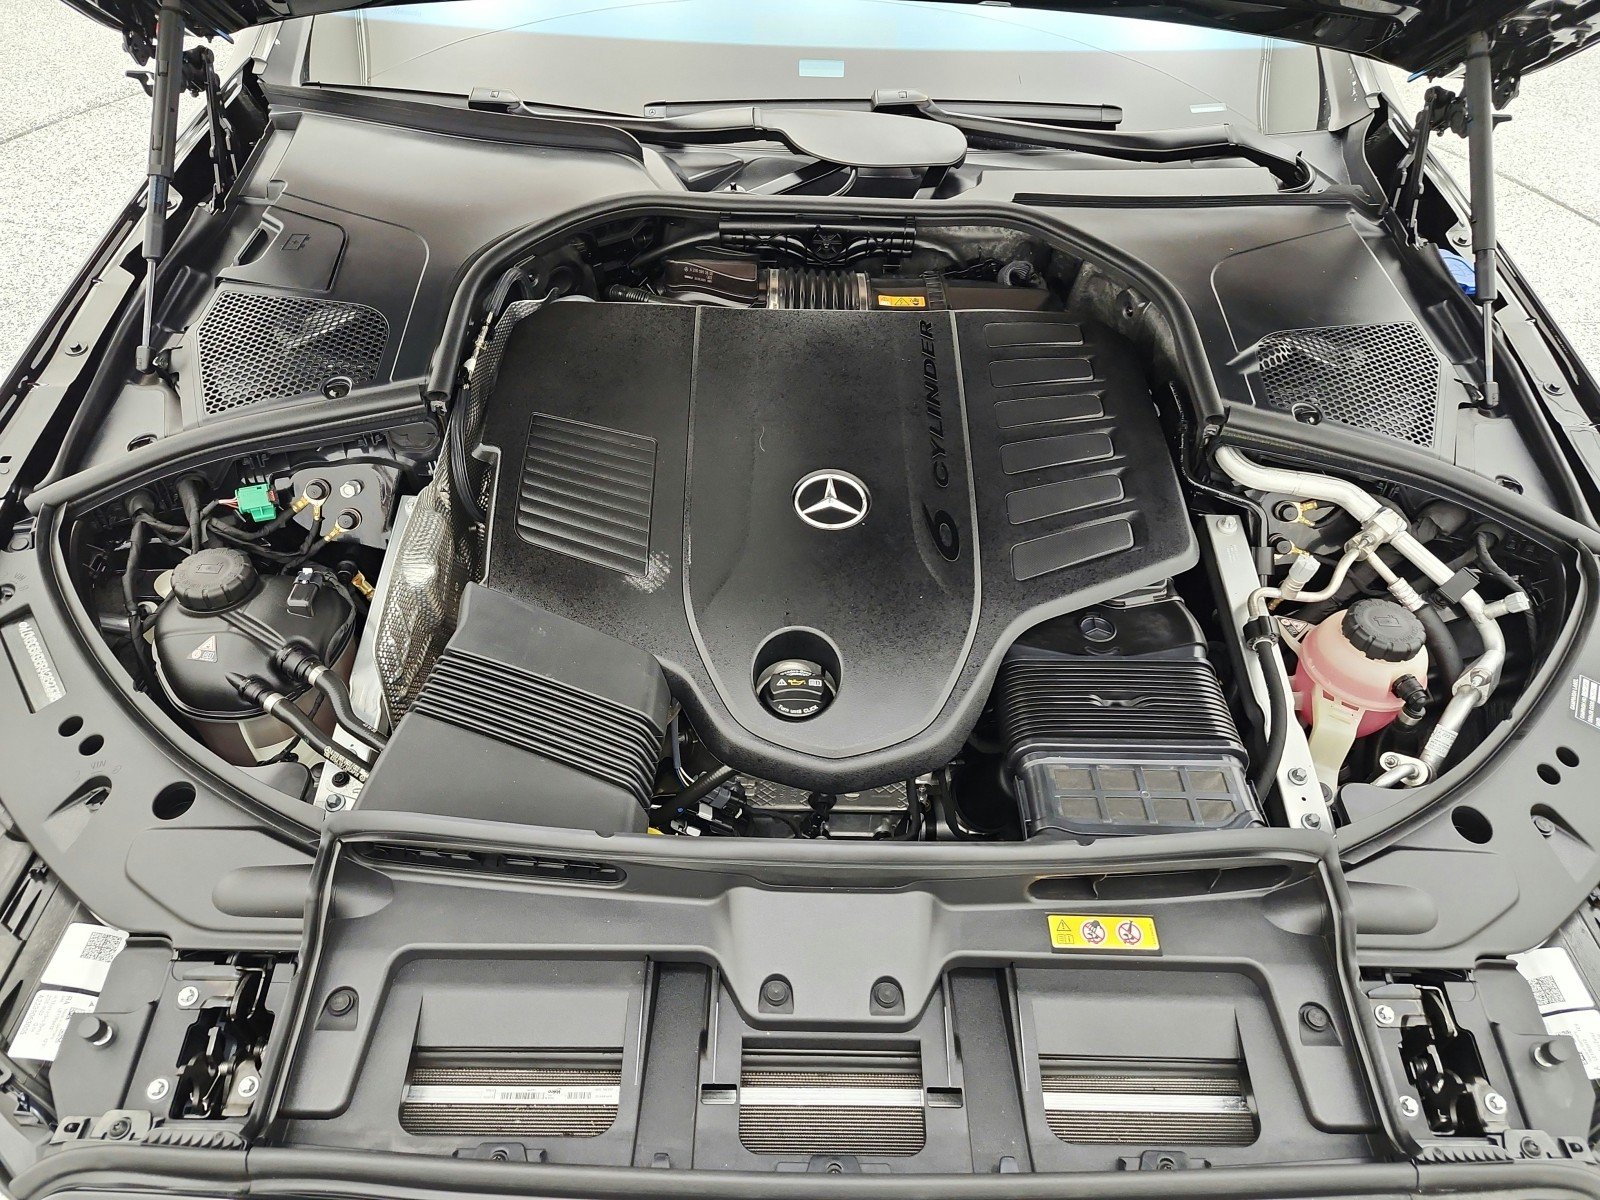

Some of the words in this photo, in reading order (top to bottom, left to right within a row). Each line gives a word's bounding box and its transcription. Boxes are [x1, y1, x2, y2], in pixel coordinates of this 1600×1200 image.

[919, 318, 949, 488] CYLINDER
[922, 501, 961, 562] 6
[777, 704, 789, 713] Turn
[803, 704, 819, 714] CLICK
